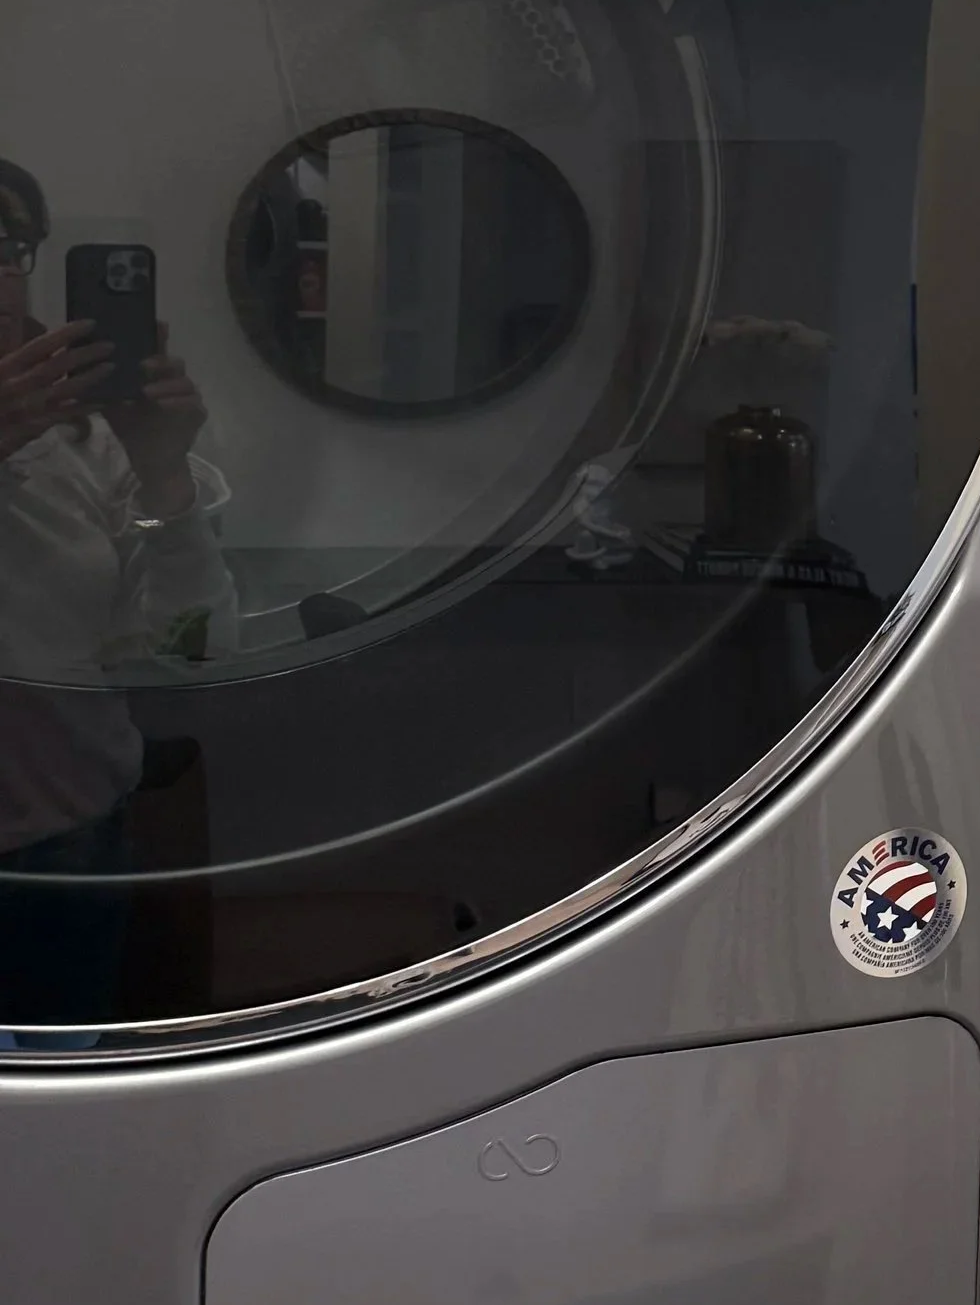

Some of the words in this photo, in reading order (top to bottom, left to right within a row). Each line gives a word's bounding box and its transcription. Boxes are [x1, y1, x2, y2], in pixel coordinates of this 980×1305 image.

[837, 835, 951, 909] AMERICA
[862, 936, 886, 952] AMERICAN
[886, 943, 910, 954] COMPANY
